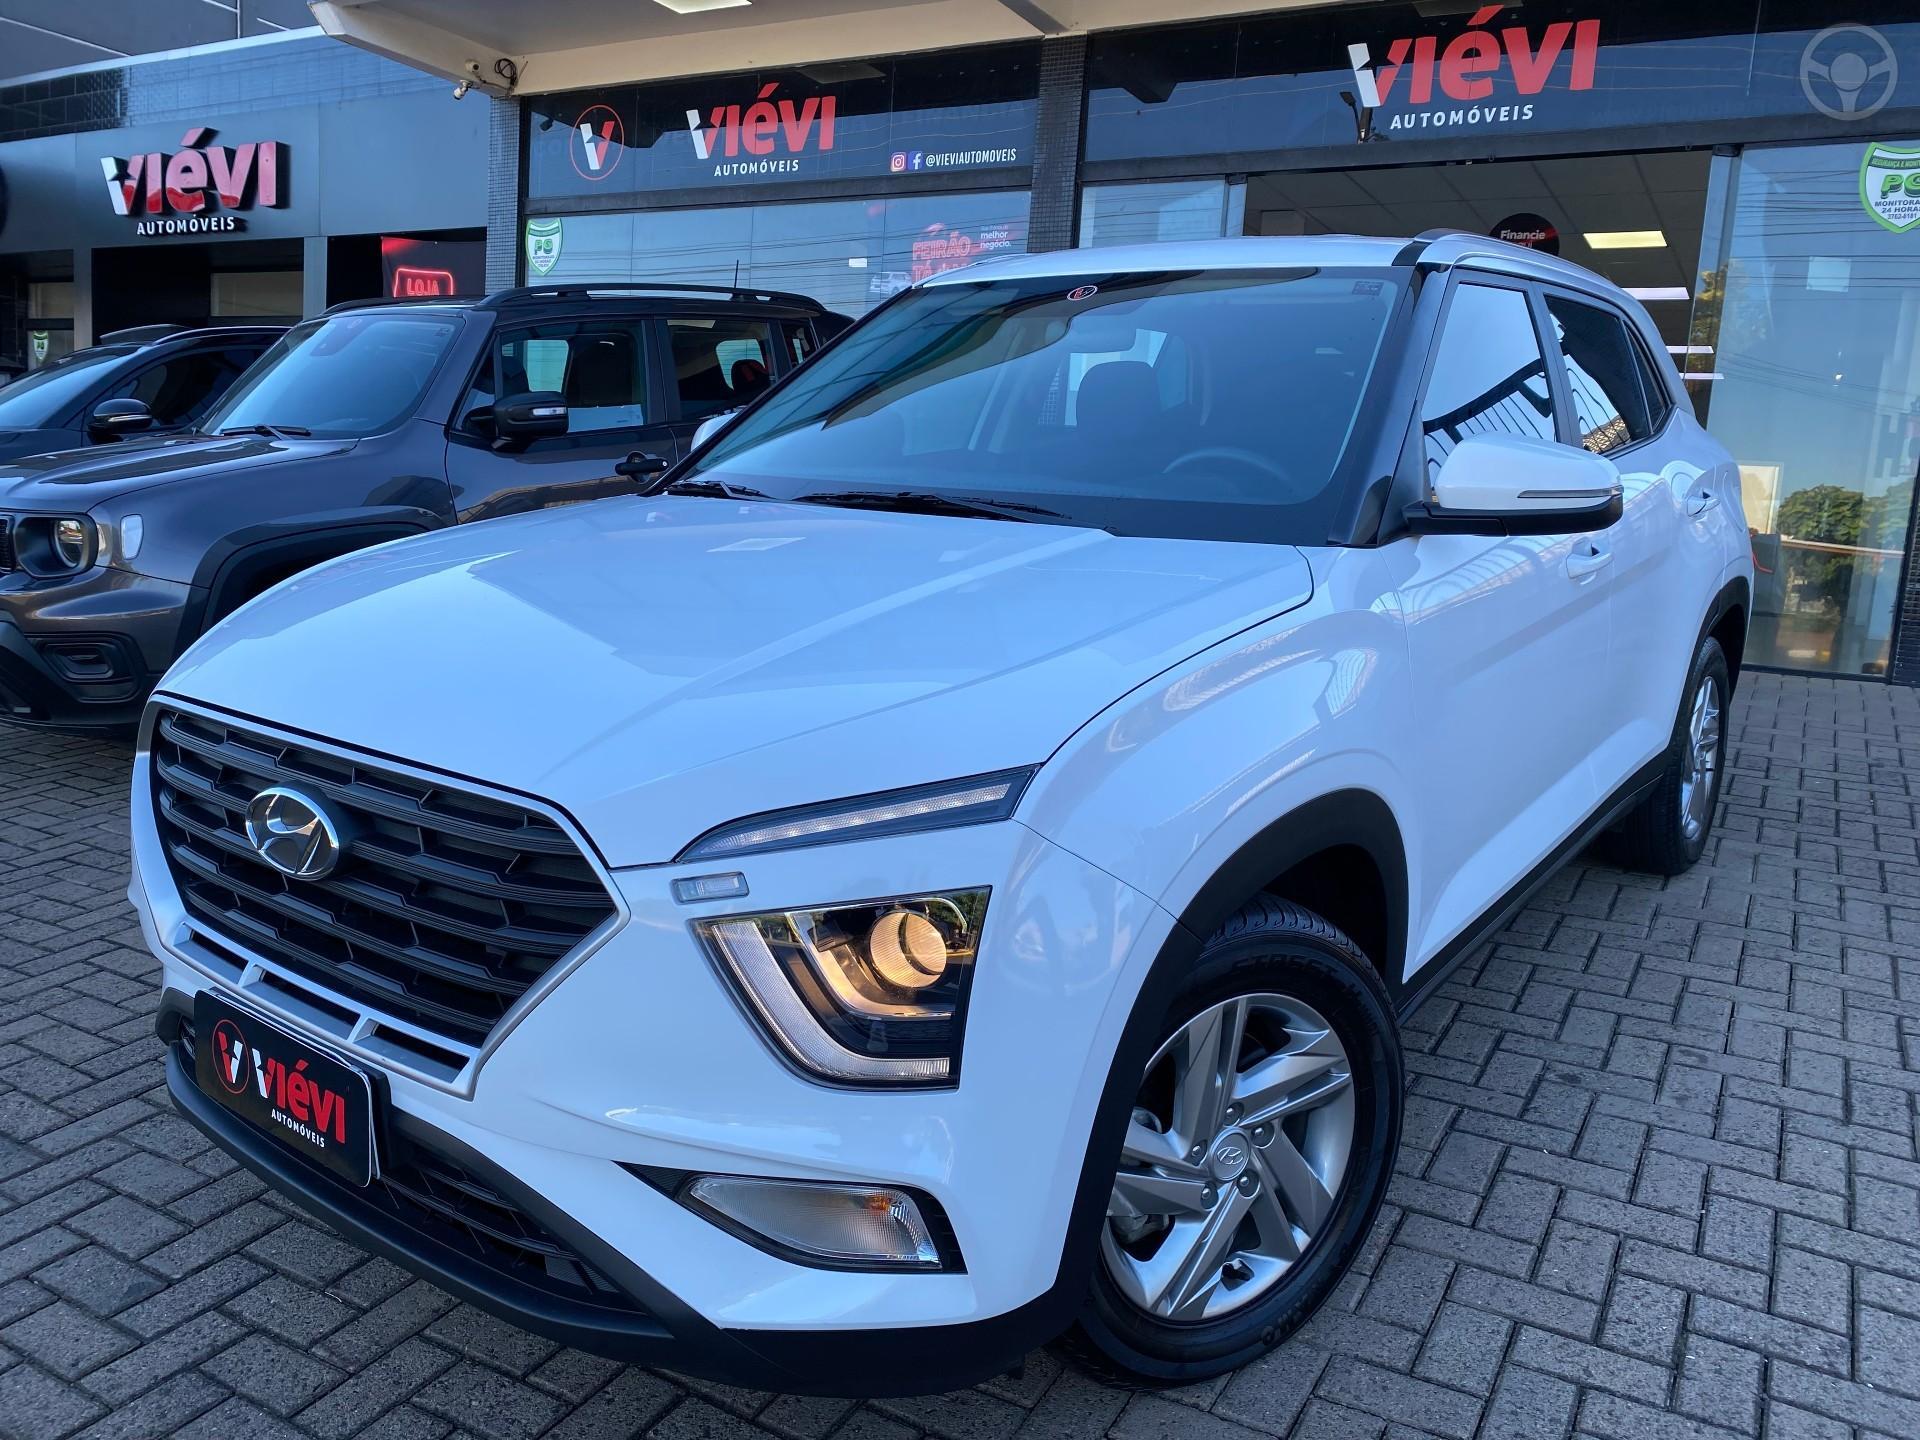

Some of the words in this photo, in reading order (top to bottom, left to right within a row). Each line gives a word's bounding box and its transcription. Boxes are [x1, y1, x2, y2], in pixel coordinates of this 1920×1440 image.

[1390, 103, 1535, 130] AUTOMÓVEIS
[713, 159, 800, 177] AUTOMÓVEIS
[925, 147, 1017, 169] @VIEVIAUTOMOVEIS
[136, 214, 236, 236] AUTOMÓVEIS
[980, 229, 1009, 239] melhor
[1500, 229, 1546, 240] Financie
[912, 231, 971, 260] FEIRÃO
[980, 239, 1012, 250] negócio.
[406, 278, 440, 296] LOJA
[271, 1107, 326, 1148] AUTOMÓVEIS
